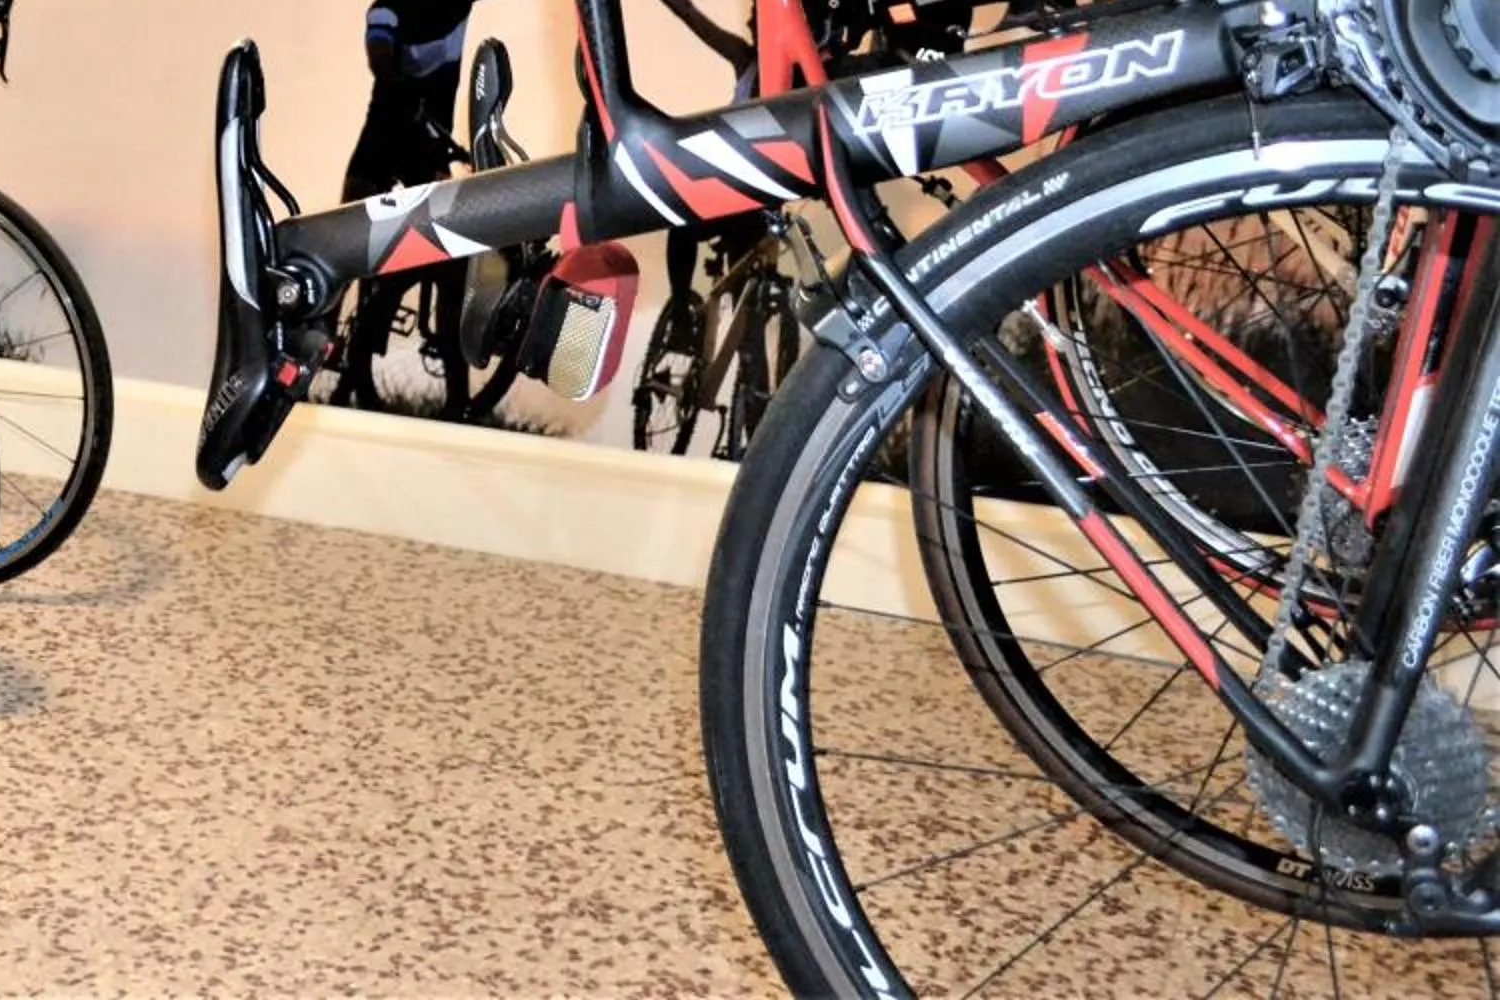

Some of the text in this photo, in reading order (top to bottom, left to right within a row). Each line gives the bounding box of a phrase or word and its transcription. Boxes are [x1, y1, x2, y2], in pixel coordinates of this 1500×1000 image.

[853, 28, 1186, 137] KRYON
[1403, 409, 1499, 668] CARBON FIBER MONOCOQUE
